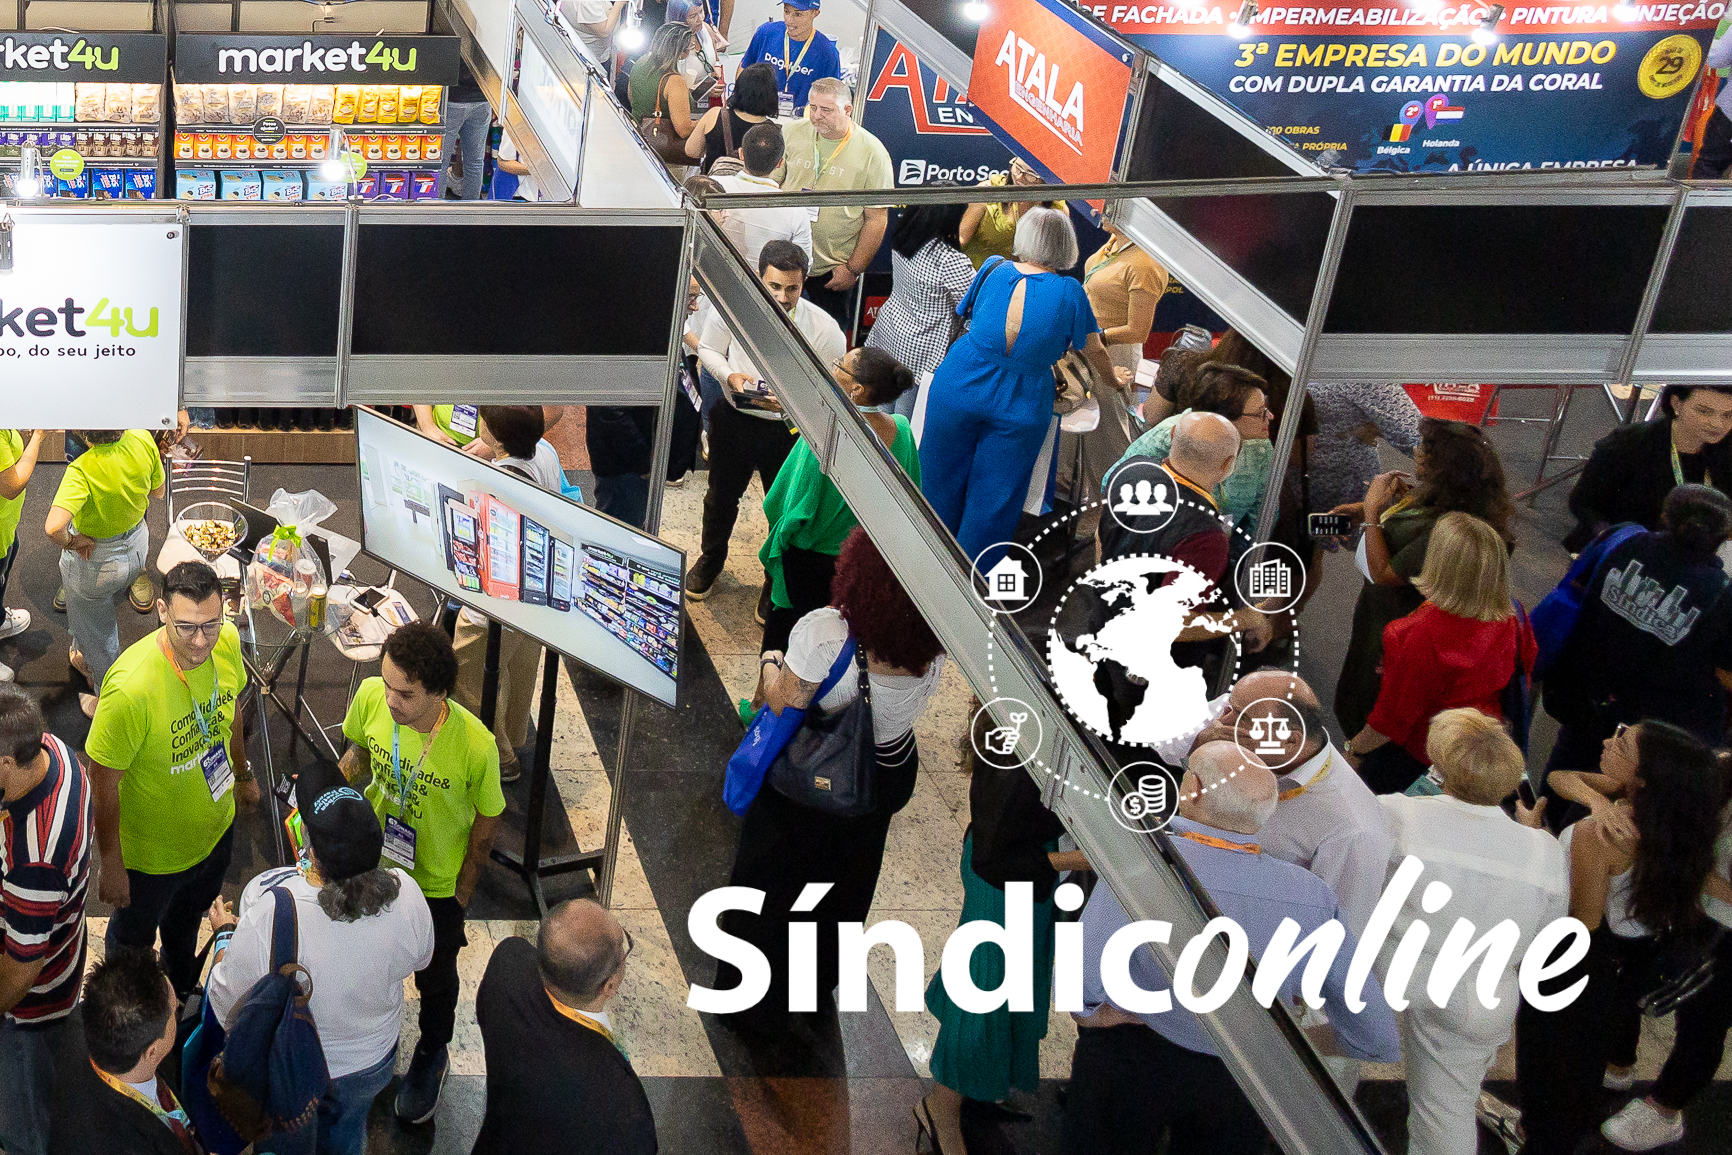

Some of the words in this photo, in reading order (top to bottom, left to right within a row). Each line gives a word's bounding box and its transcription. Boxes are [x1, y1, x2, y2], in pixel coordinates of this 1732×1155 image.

[1111, 6, 1224, 25] FACHADA
[1248, 3, 1484, 31] MPERMEABILIZAÇÃO
[1510, 5, 1611, 25] PINTURA
[218, 41, 418, 75] market4u
[1234, 41, 1269, 67] 3ª
[1274, 42, 1428, 68] EMPRESA
[1433, 42, 1486, 65] DO
[1493, 40, 1617, 65] MUNDO
[1655, 56, 1684, 75] 29
[995, 29, 1085, 133] ATALA
[1228, 75, 1282, 93] COM
[1287, 75, 1366, 93] DUPLA
[1371, 74, 1486, 93] GARANTIA
[1491, 74, 1524, 91] DA
[1528, 72, 1604, 91] CORAL
[1014, 80, 1085, 147] ENGENHARIA
[1284, 126, 1321, 135] OBRAS
[1302, 142, 1348, 151] PRÓPRIA
[1377, 145, 1410, 156] Bélgica
[1422, 139, 1460, 148] Holanda
[795, 158, 845, 178] FOST
[926, 165, 975, 182] Porto
[28, 344, 50, 357] do
[57, 348, 87, 357] seu
[93, 344, 136, 360] jeito
